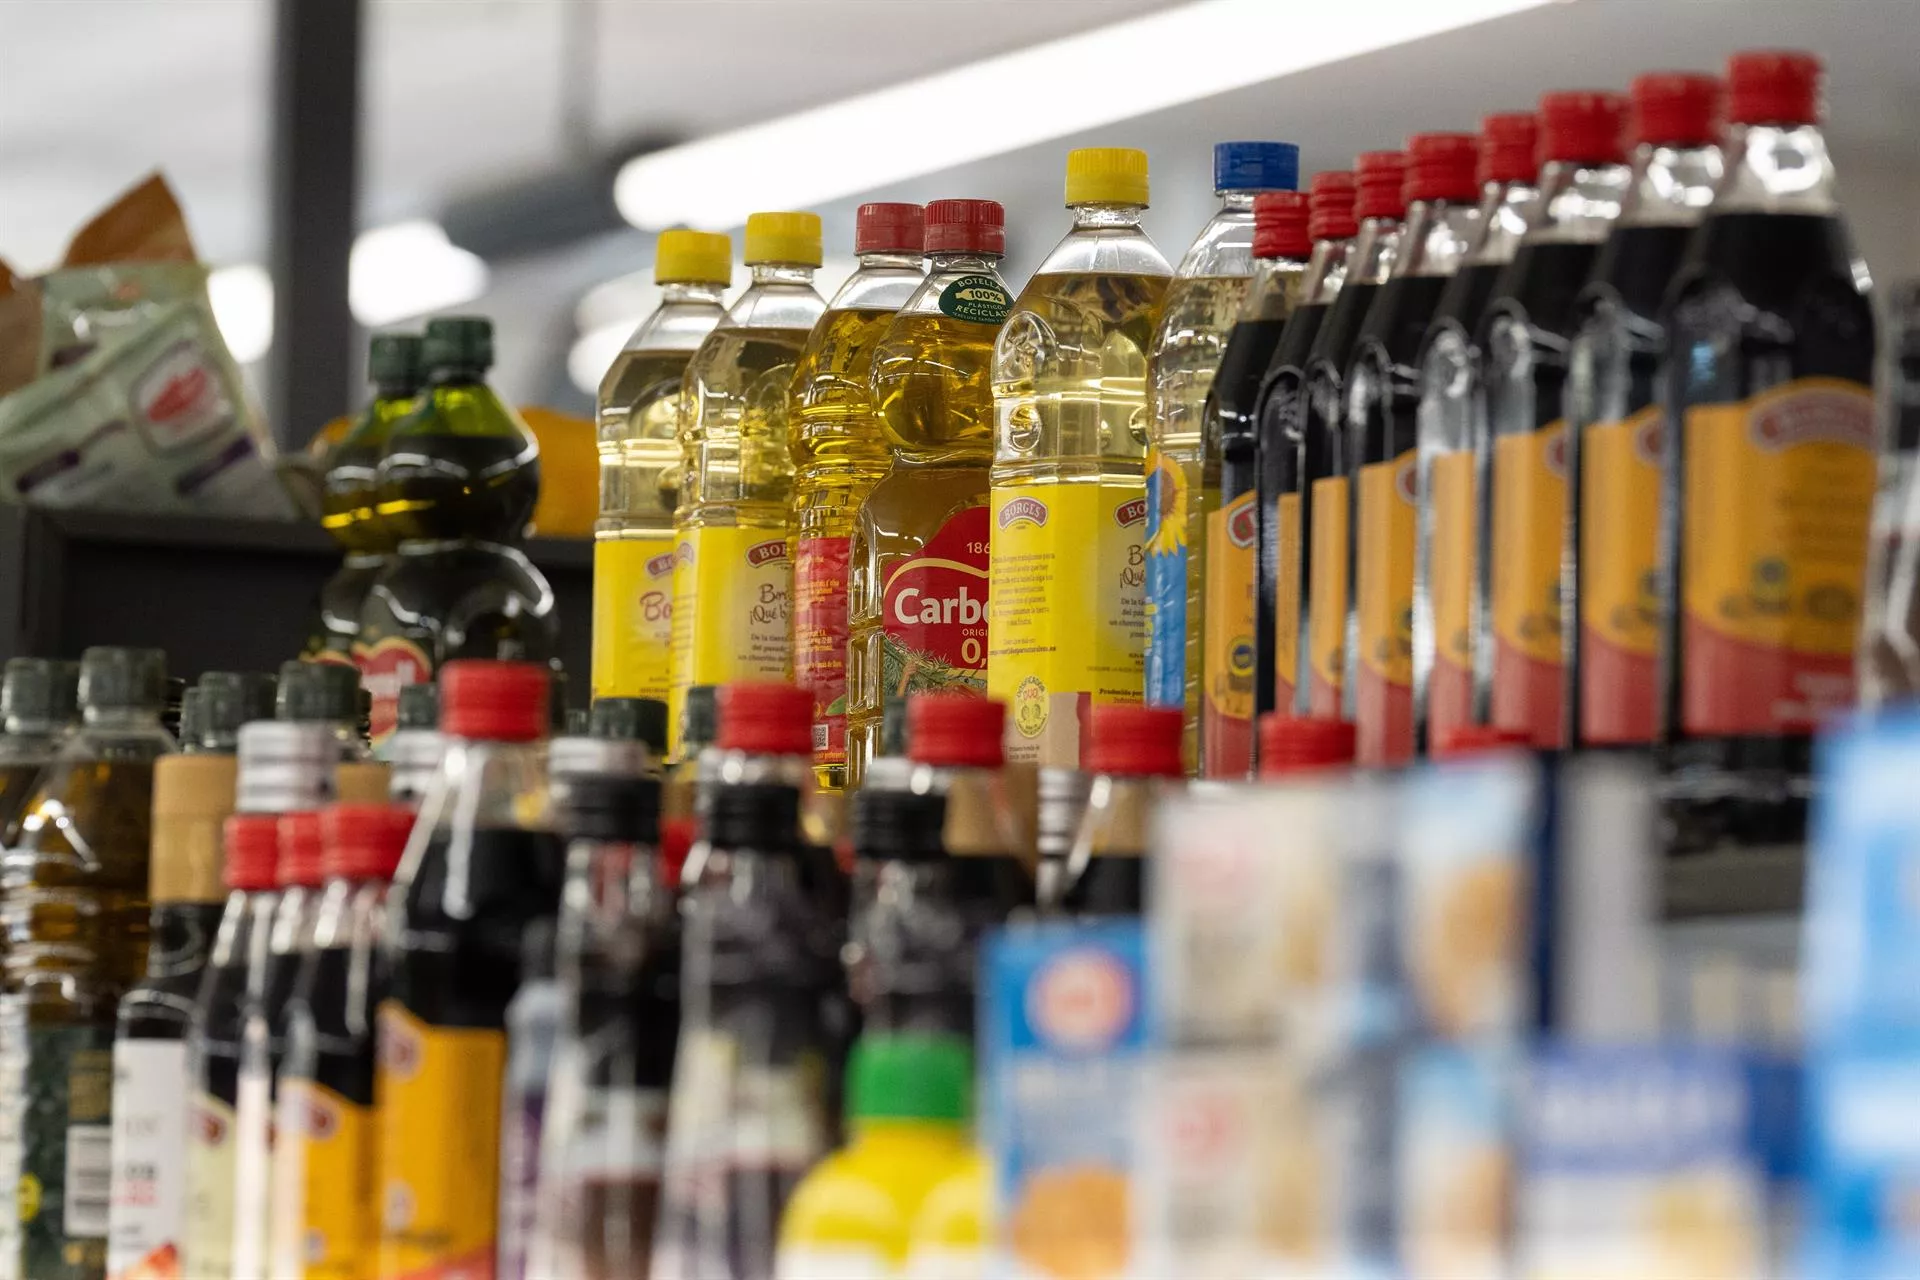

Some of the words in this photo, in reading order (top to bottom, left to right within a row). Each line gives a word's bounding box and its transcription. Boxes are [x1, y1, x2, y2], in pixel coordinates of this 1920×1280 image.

[957, 278, 1001, 292] BOTELLA
[968, 289, 1003, 302] 100%
[967, 301, 1003, 311] PLÁSTICO
[1004, 502, 1041, 520] BORGES
